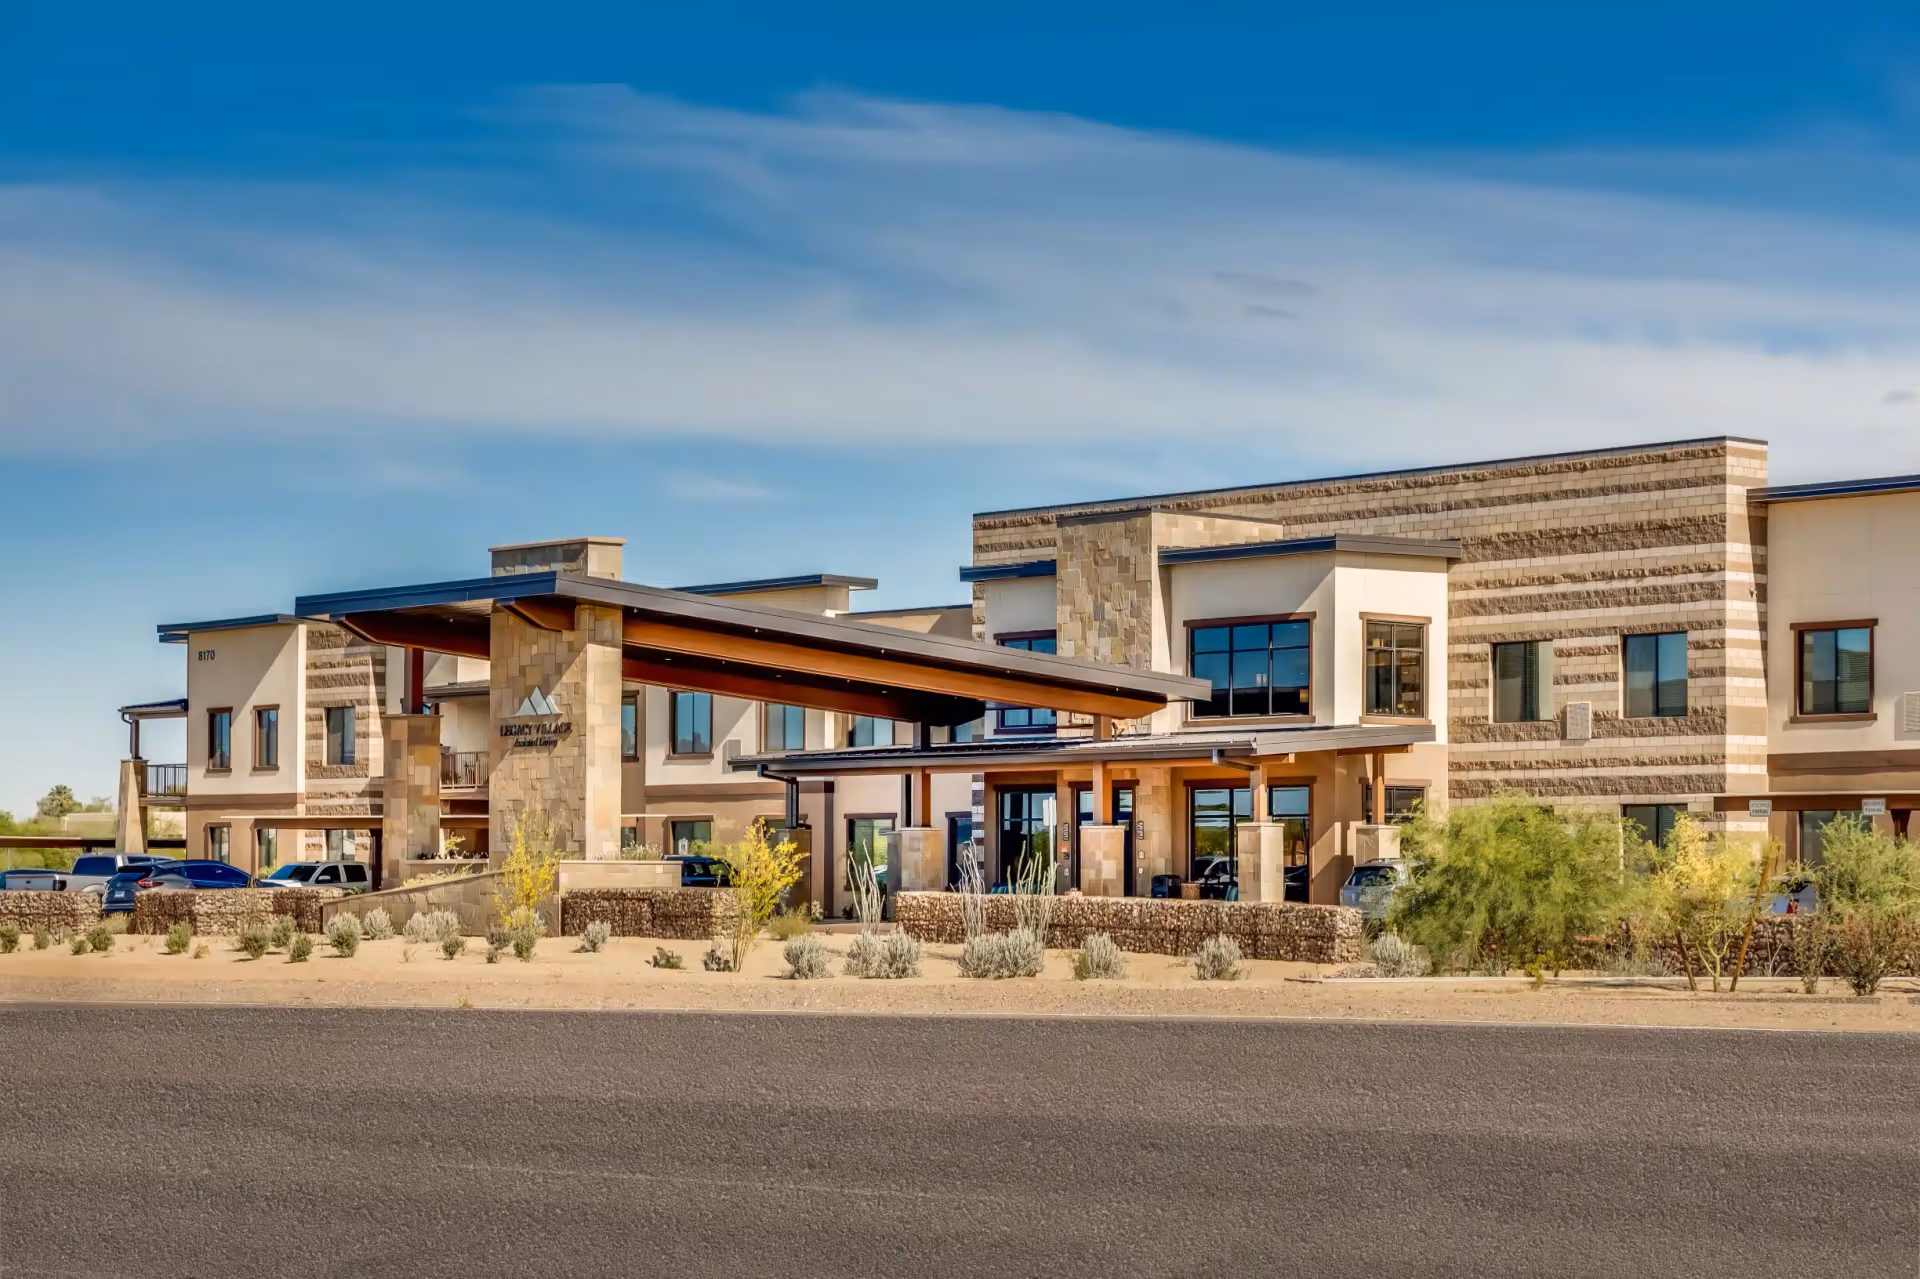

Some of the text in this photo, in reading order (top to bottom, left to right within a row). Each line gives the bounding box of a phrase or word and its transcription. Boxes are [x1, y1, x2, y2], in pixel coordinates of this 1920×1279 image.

[198, 649, 215, 661] 8170
[500, 722, 572, 737] LEGACY VILLAGE
